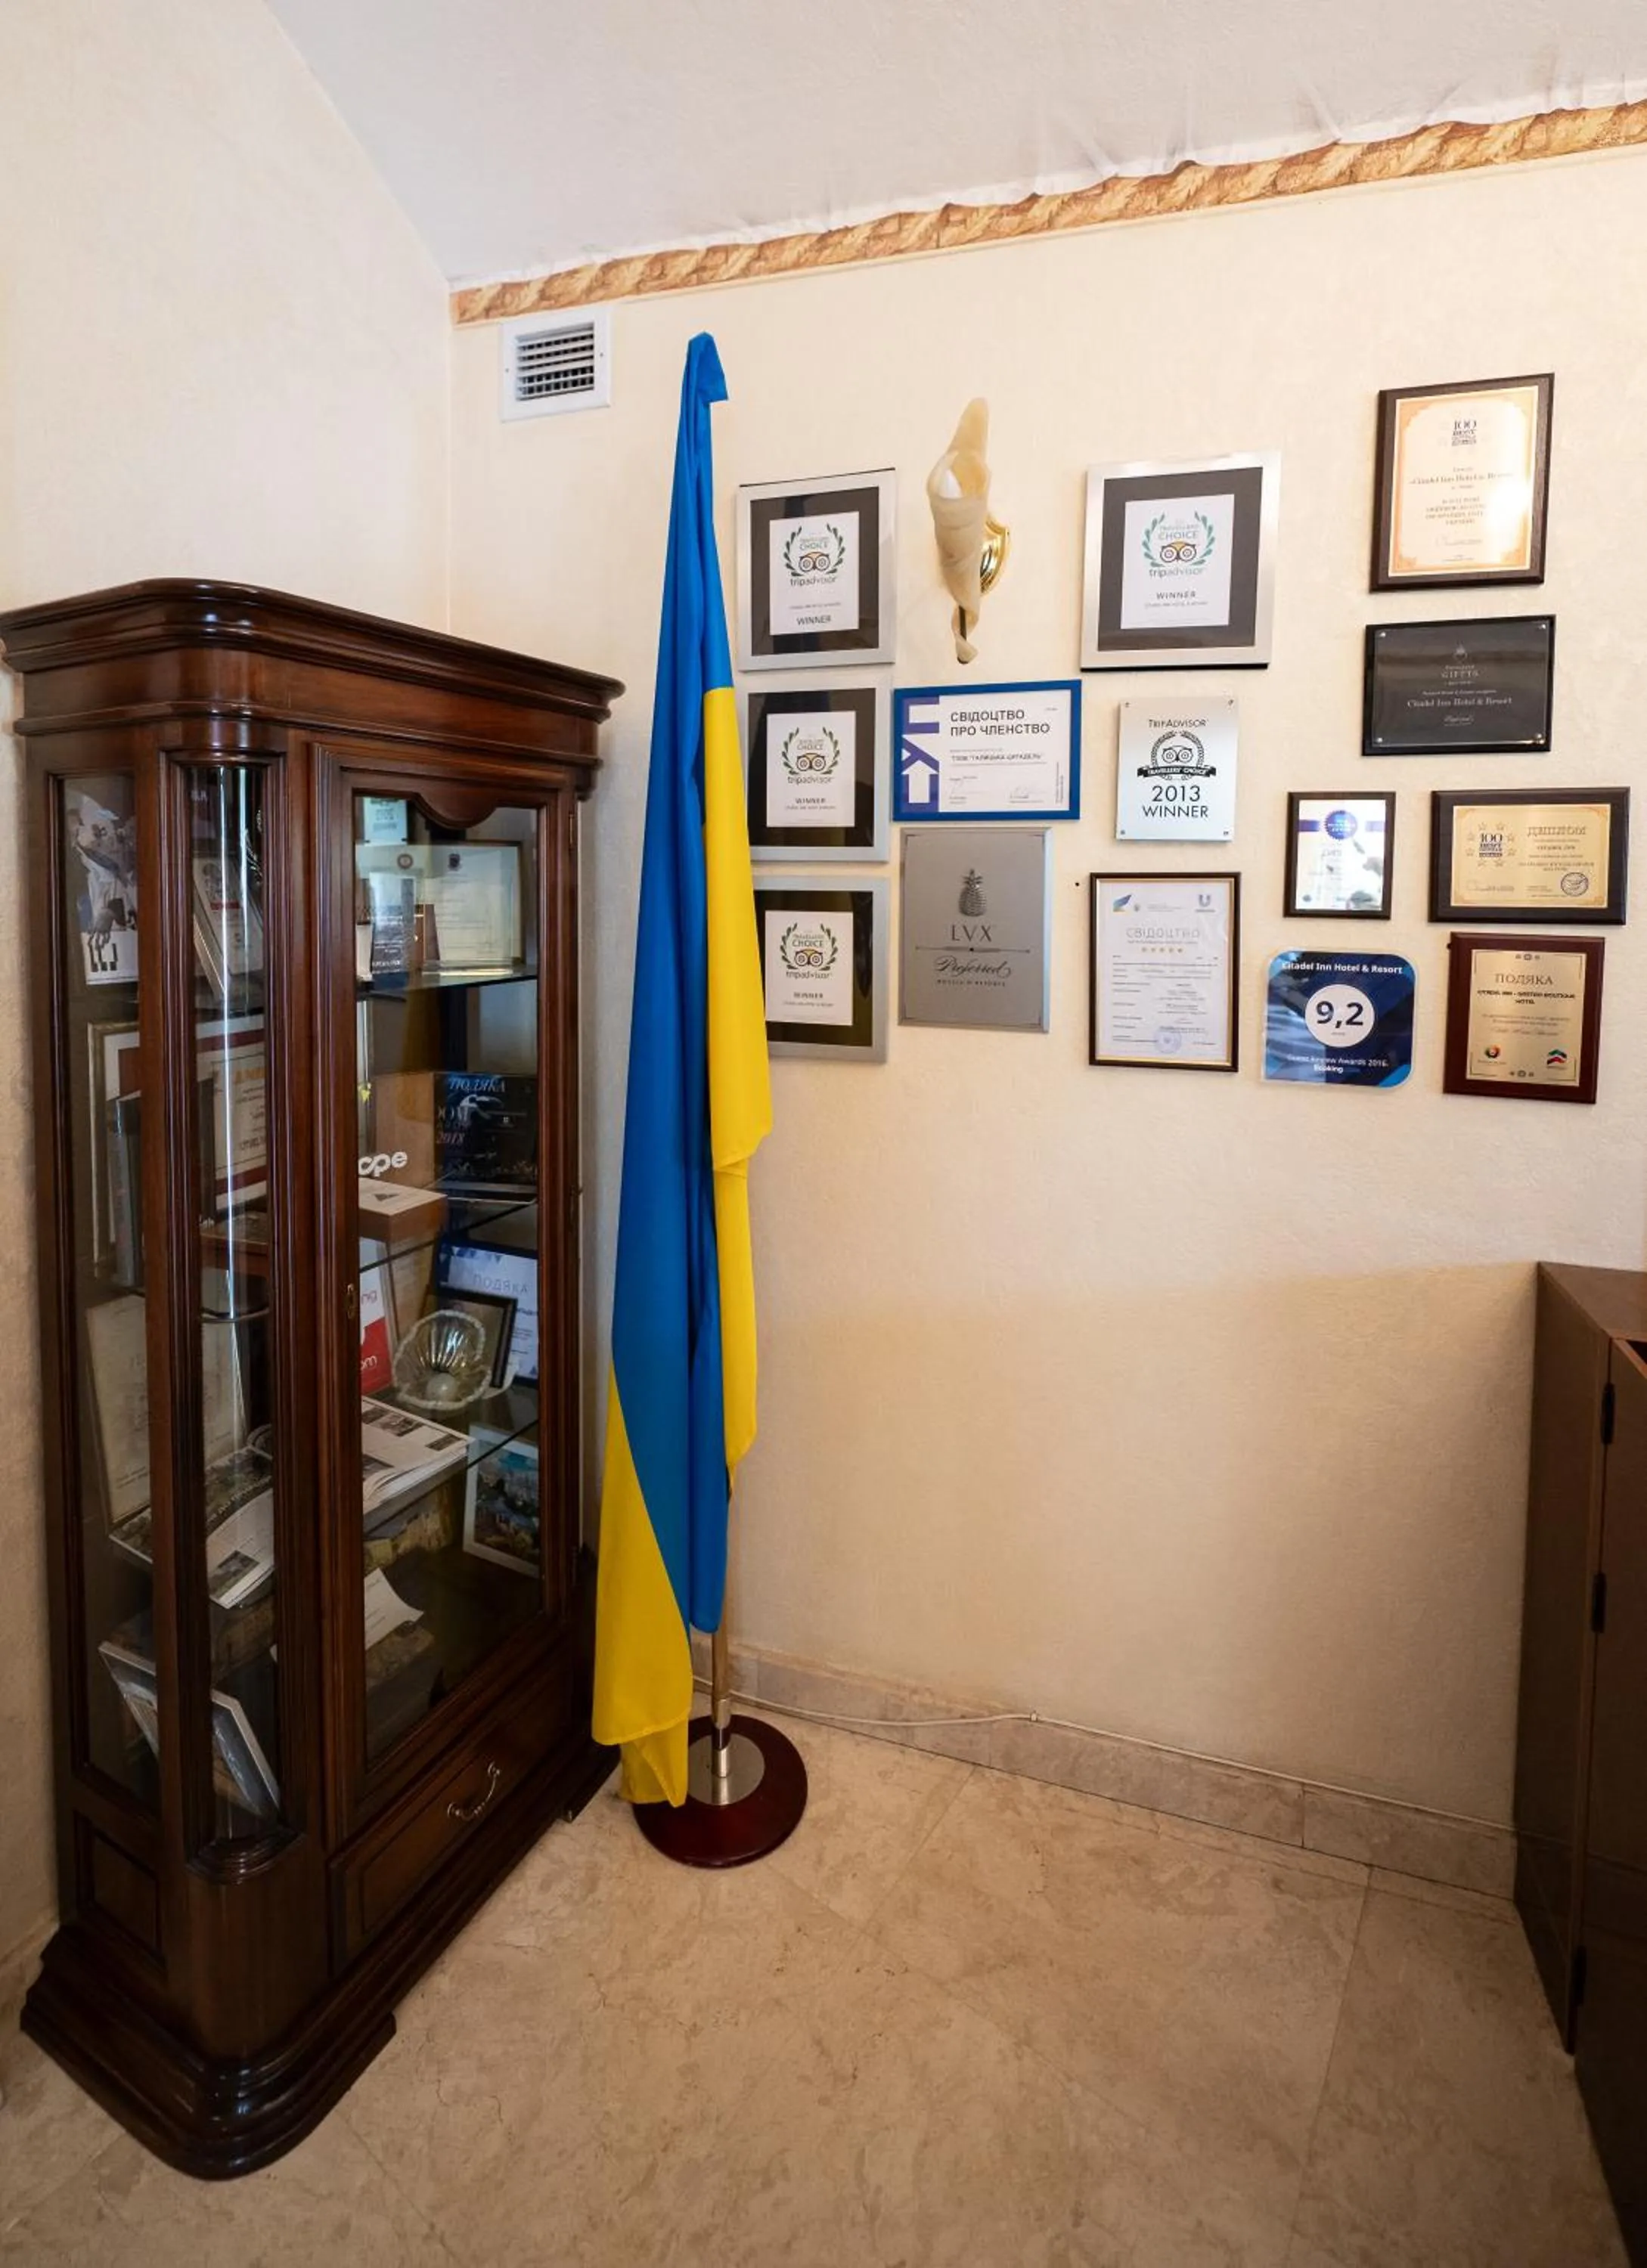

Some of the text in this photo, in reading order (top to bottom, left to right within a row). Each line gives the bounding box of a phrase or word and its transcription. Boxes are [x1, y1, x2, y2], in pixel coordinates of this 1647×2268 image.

[1158, 531, 1199, 540] CHOICE
[1149, 567, 1203, 578] tripadvisor
[789, 575, 837, 587] tripadvisor
[1156, 590, 1196, 600] WINNER
[796, 615, 831, 625] WINNER
[951, 710, 1025, 723] СВІДОЦТВО
[951, 723, 1050, 736] ПРО ЧЛЕНСТВО
[787, 776, 832, 785] tripadvisor
[1152, 785, 1201, 802] 2013
[1142, 805, 1209, 817] WINNER
[1481, 833, 1503, 843] 100
[1527, 826, 1587, 838] ДИПЛОМ
[951, 925, 992, 942] LVX
[1126, 927, 1200, 939] СВІДОЦТВО
[1282, 962, 1314, 971] Citadel
[1334, 964, 1360, 972] Hotel
[1371, 965, 1404, 974] Resort
[1494, 973, 1554, 985] ПОДЯКА
[1316, 1001, 1364, 1029] 9,2
[1338, 1058, 1366, 1067] Awards
[473, 1274, 529, 1294] ПОДЯКА
